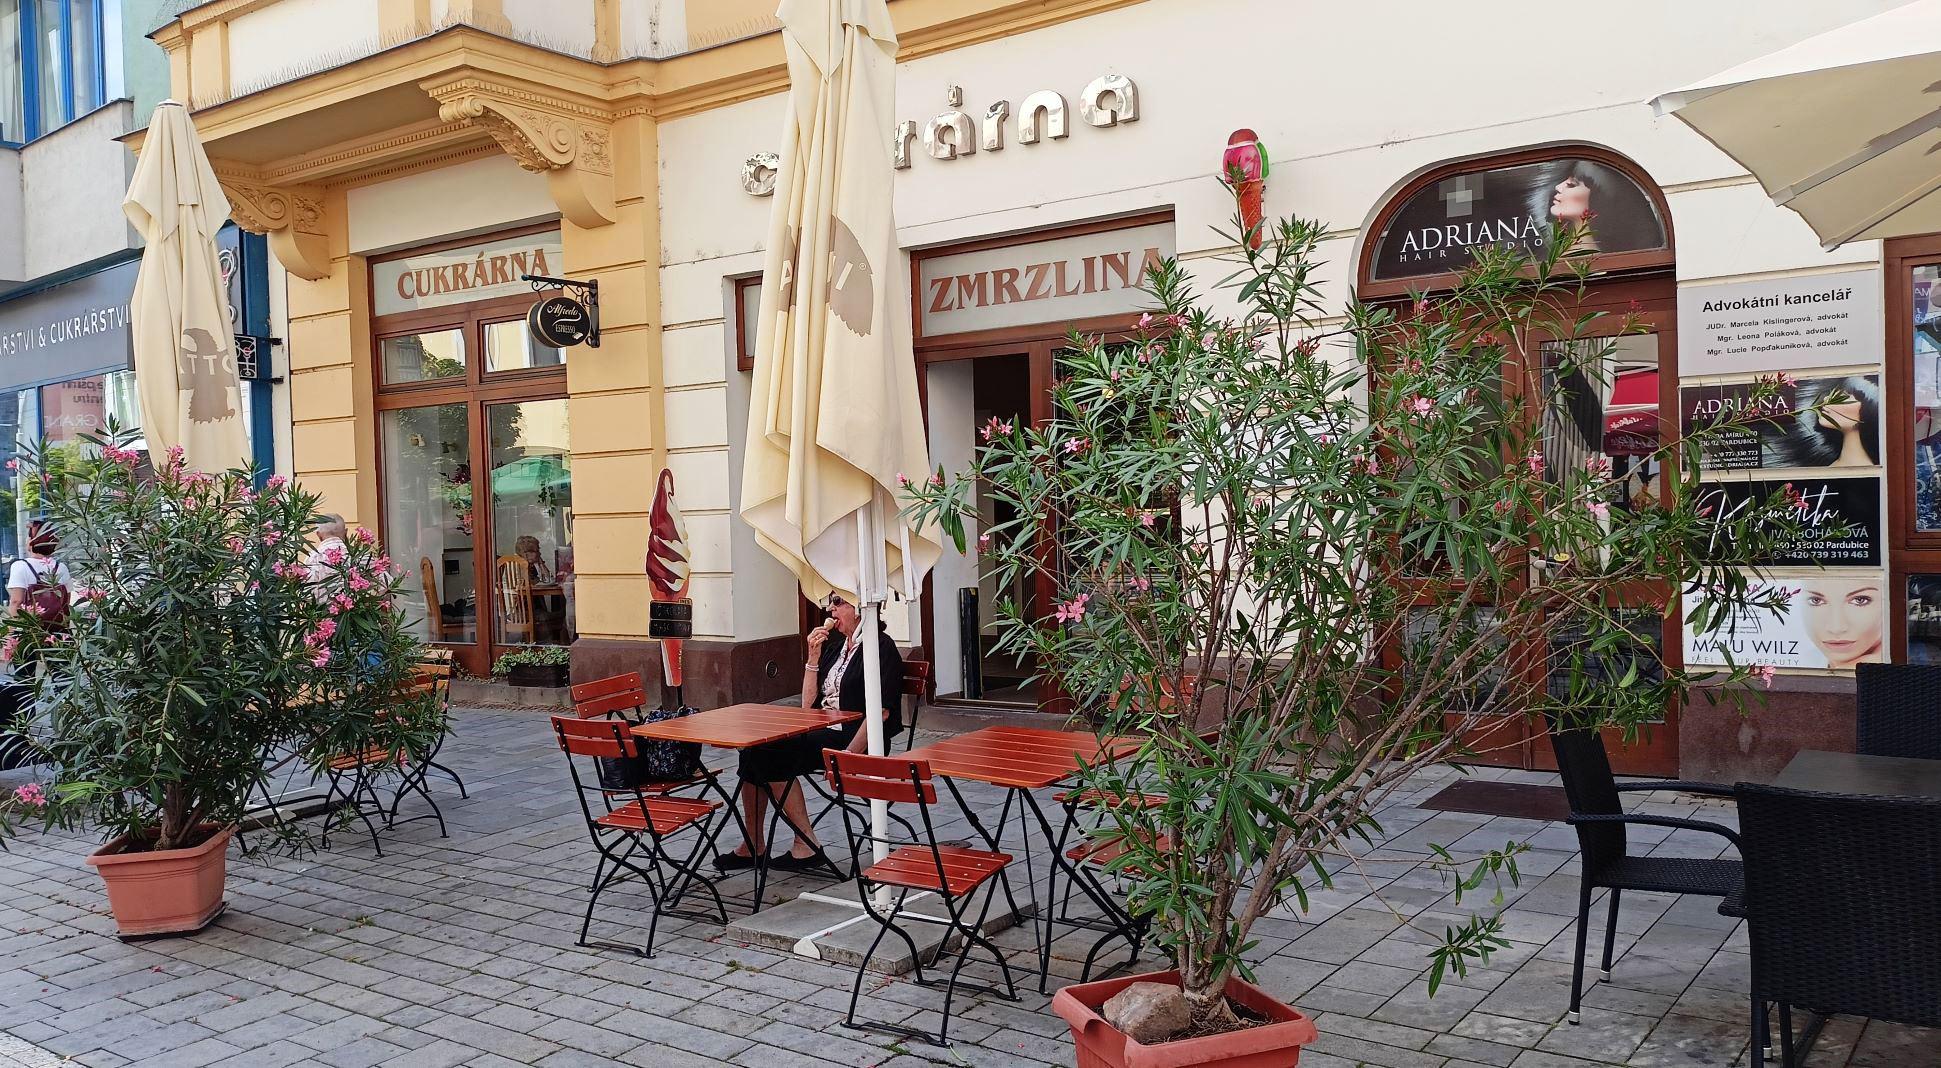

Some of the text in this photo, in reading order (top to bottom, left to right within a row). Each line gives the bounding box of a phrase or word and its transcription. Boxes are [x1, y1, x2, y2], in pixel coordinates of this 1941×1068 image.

[1400, 214, 1540, 253] ADRIANA
[1399, 249, 1447, 263] HAIR
[397, 248, 550, 300] CUKRÁRNA
[928, 247, 1163, 314] ZMRZLINA
[1702, 287, 1852, 313] Advokátní kancelář
[1730, 320, 1759, 328] Marcela
[1805, 327, 1837, 335] advokát
[38, 326, 46, 348] &
[1817, 339, 1848, 347] advokát
[1692, 395, 1789, 414] ADRIANA
[1813, 541, 1825, 549] 02
[1826, 540, 1869, 549] Pardubice
[1785, 550, 1869, 559] +420 739 319 463
[1752, 640, 1799, 655] WILZ
